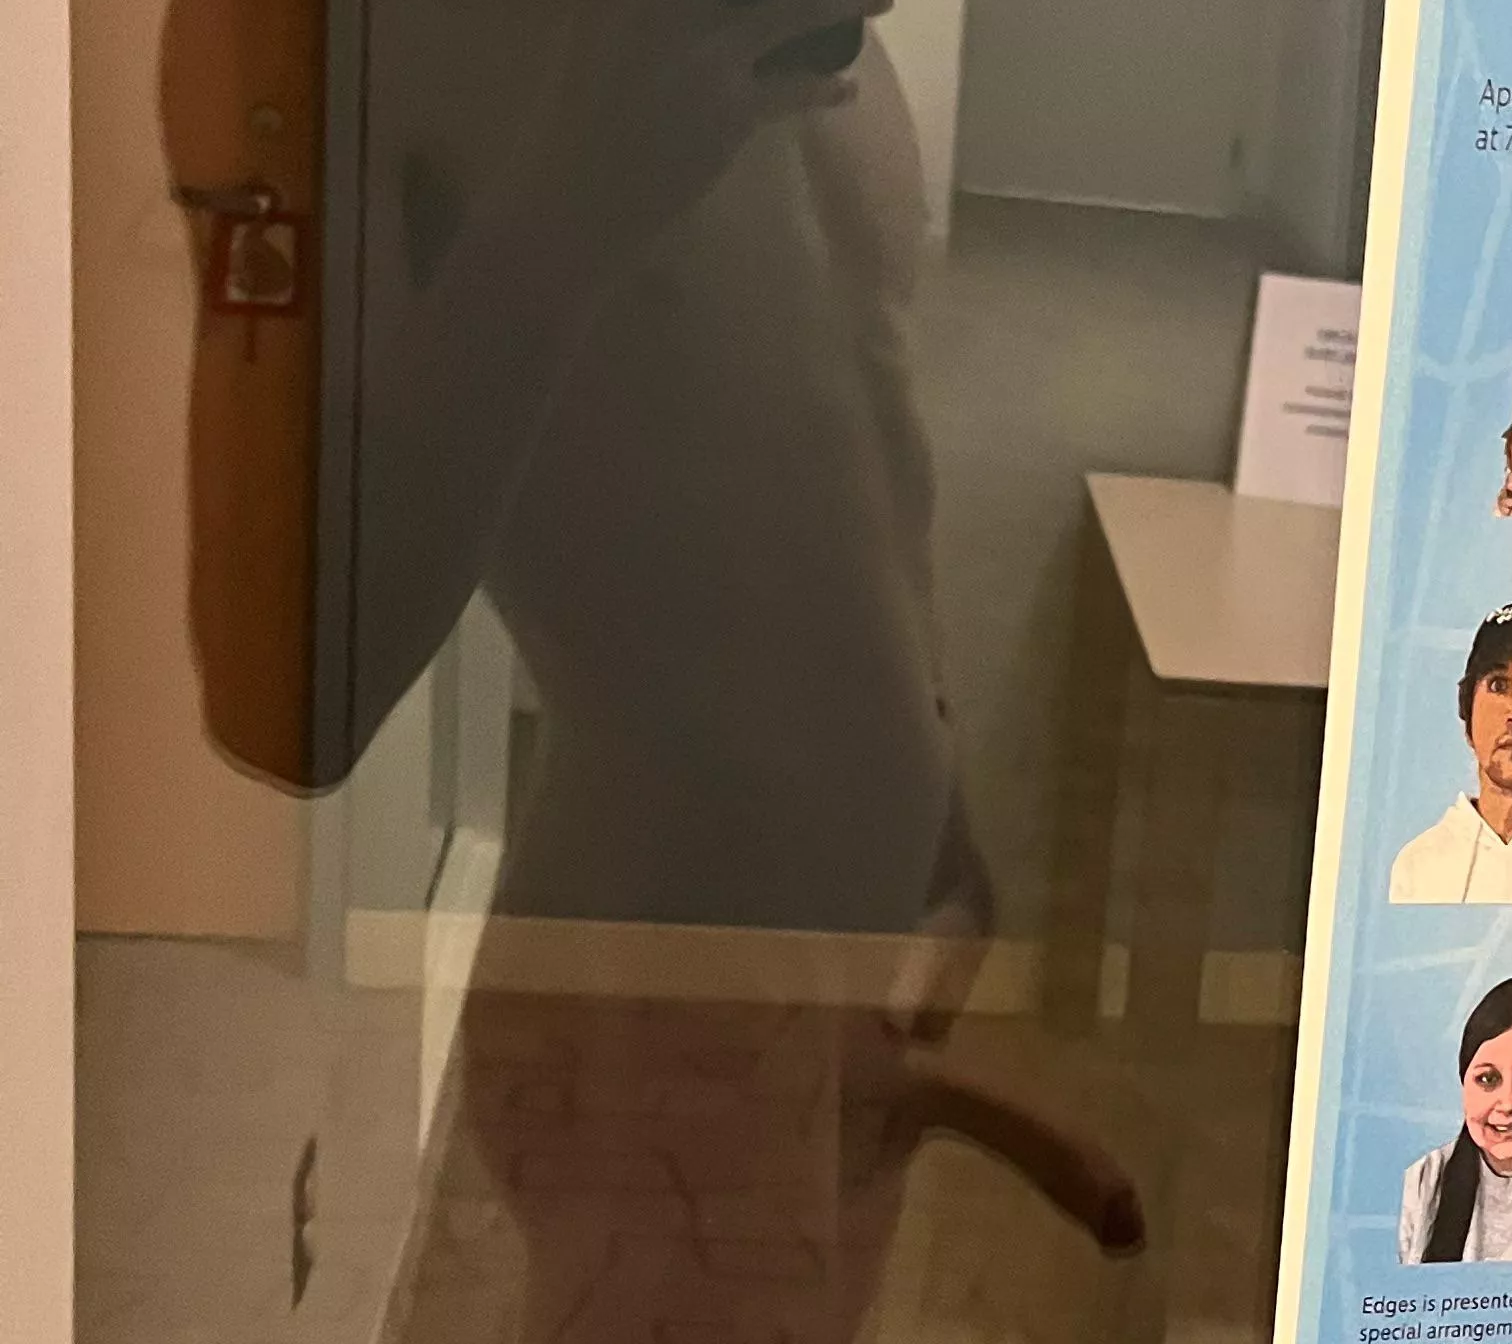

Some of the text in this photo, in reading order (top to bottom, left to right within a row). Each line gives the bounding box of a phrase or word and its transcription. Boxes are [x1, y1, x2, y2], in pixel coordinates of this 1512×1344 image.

[1475, 126, 1498, 152] at
[1362, 1296, 1417, 1317] Edges
[1423, 1294, 1436, 1312] is
